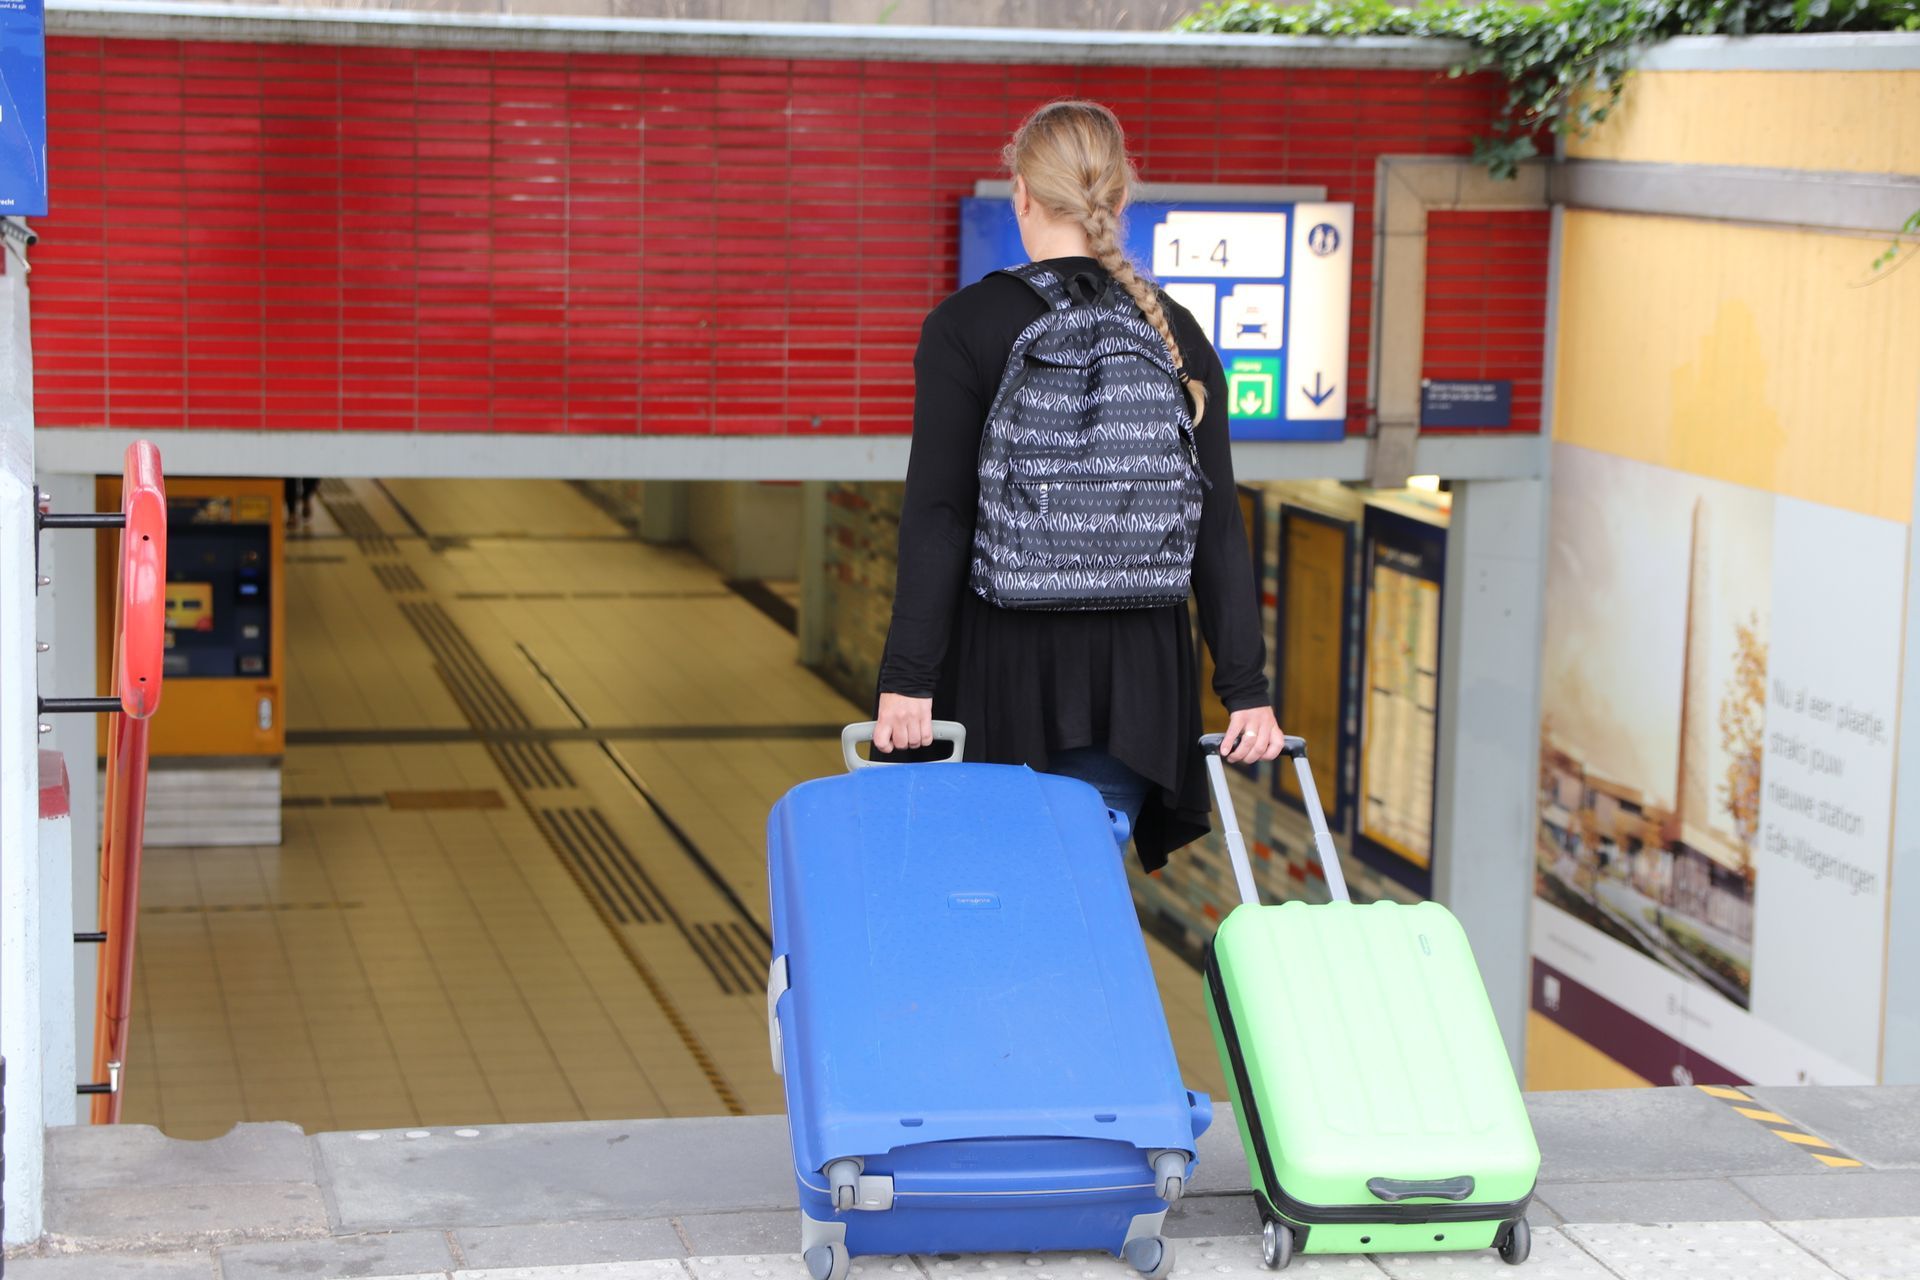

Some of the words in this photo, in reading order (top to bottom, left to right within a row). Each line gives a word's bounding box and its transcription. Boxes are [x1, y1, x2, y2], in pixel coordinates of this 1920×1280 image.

[1169, 238, 1180, 267] 1
[1210, 238, 1229, 267] 4
[1808, 695, 1835, 723] een
[1767, 780, 1815, 819] nieuwe
[1817, 800, 1865, 837] station
